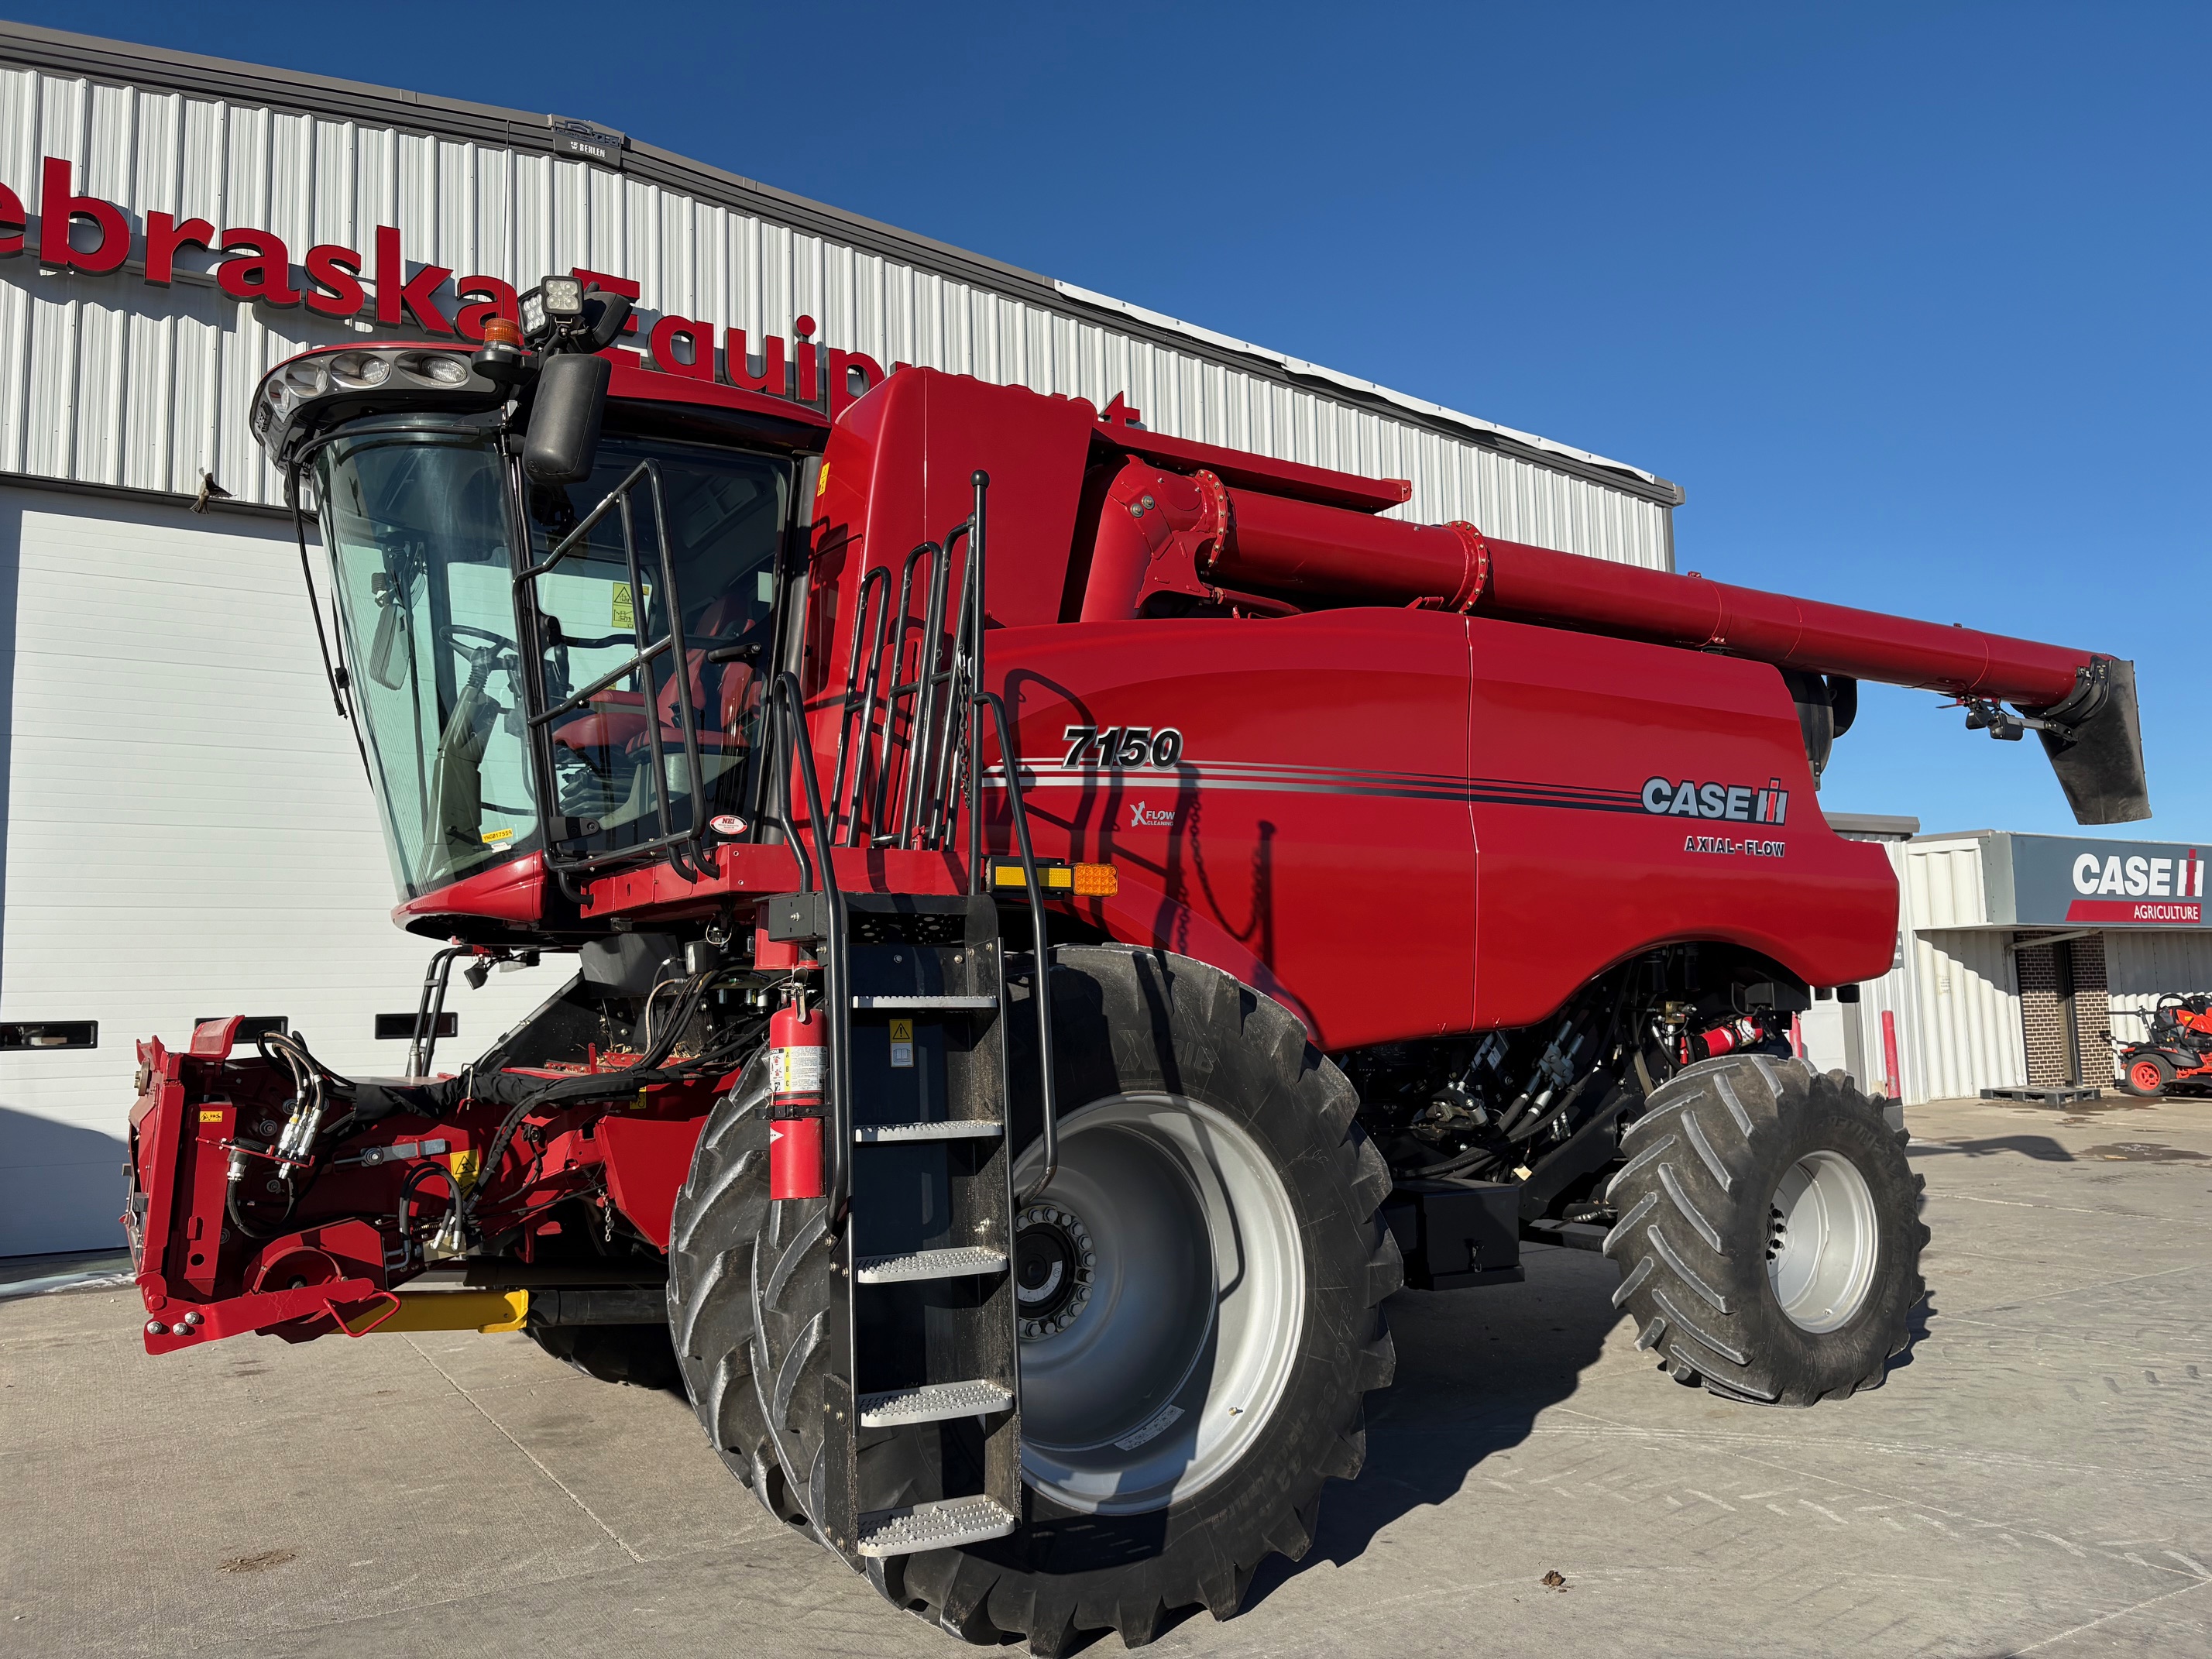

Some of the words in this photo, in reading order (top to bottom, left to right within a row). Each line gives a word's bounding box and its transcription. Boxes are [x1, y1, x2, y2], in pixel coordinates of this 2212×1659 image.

[579, 143, 606, 158] BEHLEN
[1060, 724, 1183, 771] 7150
[1642, 777, 1752, 820] CASE
[1146, 810, 1175, 820] FLOW
[1684, 836, 1786, 857] AXIAL-FLOW
[2072, 853, 2172, 897] CASE
[2133, 904, 2200, 921] AGRICULTURE
